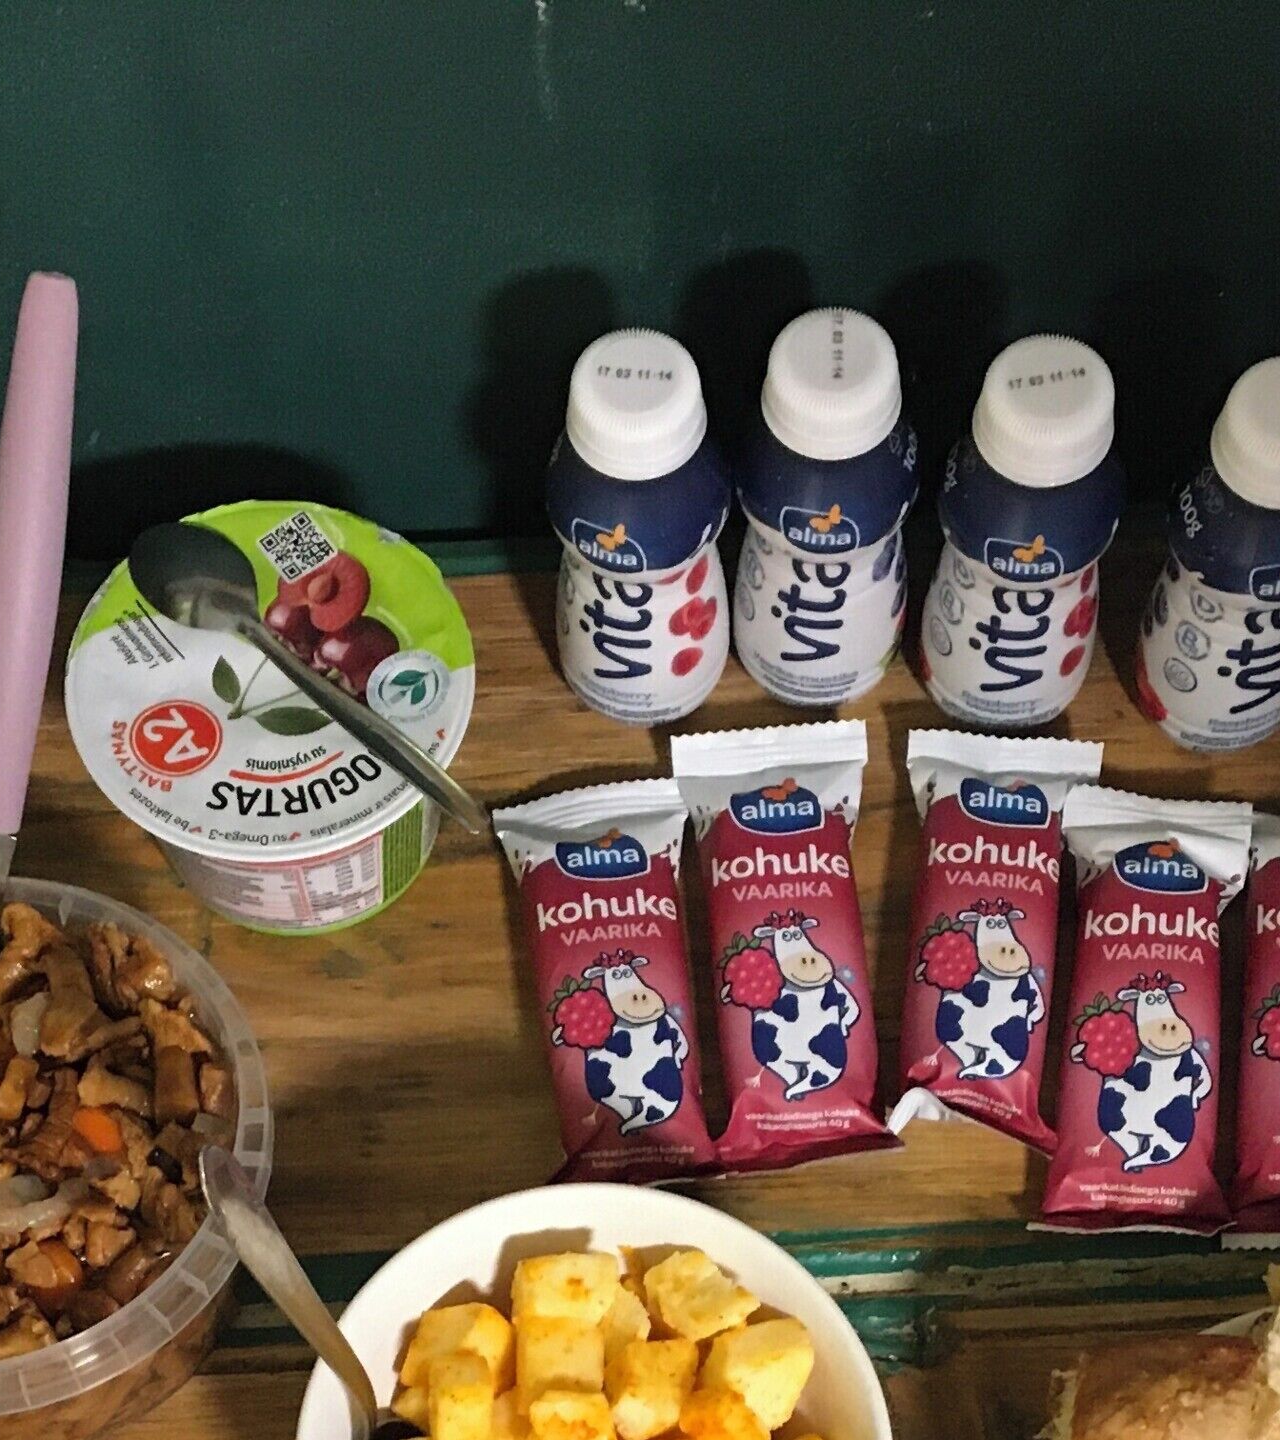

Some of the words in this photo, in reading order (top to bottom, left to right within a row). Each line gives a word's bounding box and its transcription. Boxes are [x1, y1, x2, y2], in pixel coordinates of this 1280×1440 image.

[788, 525, 852, 546] alma
[579, 536, 638, 566] alma
[991, 552, 1055, 575] alma
[771, 558, 851, 662] vita
[579, 571, 653, 679] vita
[968, 586, 1054, 692] vita
[142, 707, 210, 764] A2
[111, 719, 173, 792] BALTYMAS
[246, 751, 312, 772] vyšniomis
[311, 745, 327, 761] su
[206, 754, 383, 817] OGURTAS
[128, 787, 174, 824] laktozes
[740, 792, 815, 821] alma
[968, 787, 1042, 815] alma
[174, 817, 190, 832] be
[310, 806, 374, 838] mineralais
[208, 828, 269, 846] Omega-3
[566, 842, 641, 869] alma
[711, 843, 851, 888] kohuke
[928, 835, 1061, 884] kohuke
[1123, 855, 1199, 881] alma
[732, 881, 833, 902] VAARIKA
[944, 869, 1045, 897] VAARIKA
[536, 887, 677, 933] kohuke
[560, 921, 662, 947] VAARIKA
[1085, 903, 1220, 948] kohuke
[1102, 941, 1205, 965] VAARIKA
